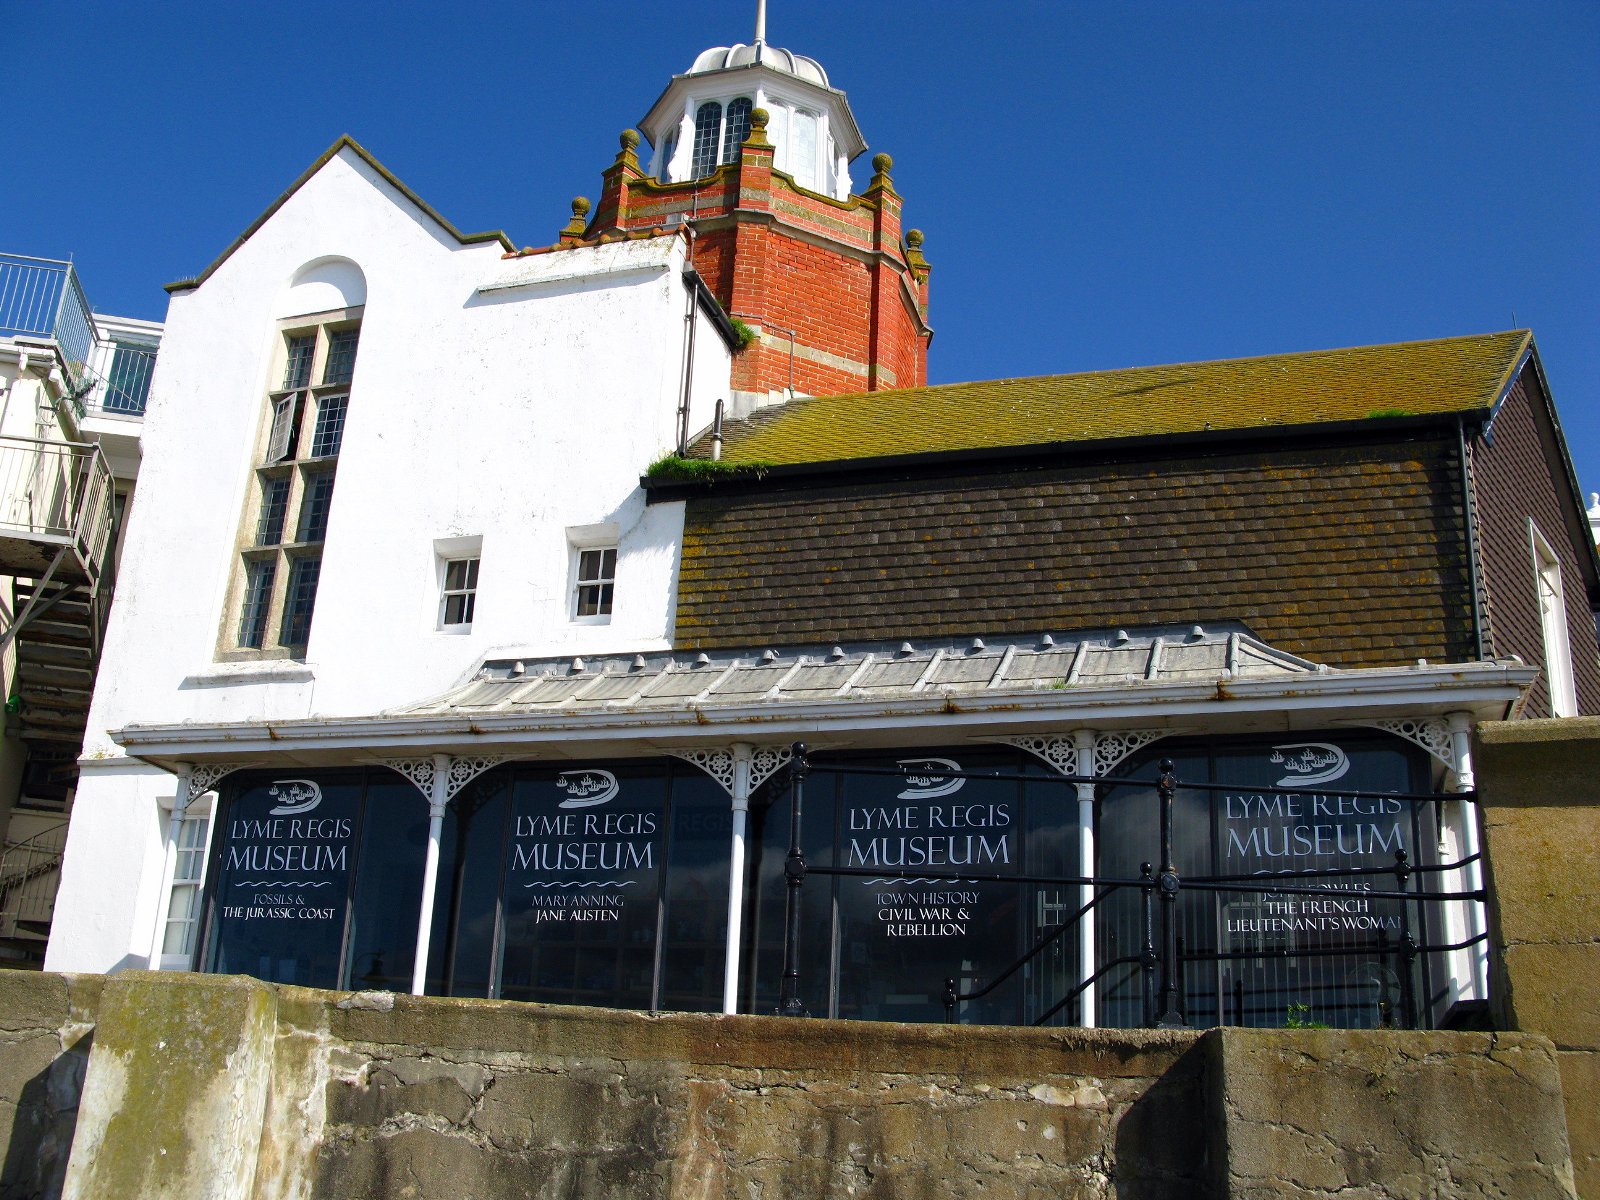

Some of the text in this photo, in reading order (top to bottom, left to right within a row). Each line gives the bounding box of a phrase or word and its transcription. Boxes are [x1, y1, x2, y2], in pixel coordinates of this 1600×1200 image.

[1225, 790, 1402, 819] LYME REGIS
[515, 812, 656, 836] LYME REGIS
[849, 803, 1010, 830] LYME REGIS
[231, 818, 352, 839] LYME REGIS
[1227, 823, 1404, 858] MUSEUM
[226, 845, 348, 871] MUSEUM
[511, 842, 653, 871] MUSEUM
[847, 834, 1010, 867] MUSEUM
[253, 893, 305, 905] FOSSILS &
[532, 895, 625, 907] MARY ANNING
[876, 891, 981, 905] TOWN HISTORY
[223, 906, 336, 921] THE JURASSIC COAST
[878, 907, 971, 921] CIVIL WAR &
[1268, 899, 1369, 915] THE FRENCH
[536, 909, 619, 924] JANE AUSTEN
[1341, 915, 1401, 931] WOMA
[887, 923, 967, 937] REBELLION
